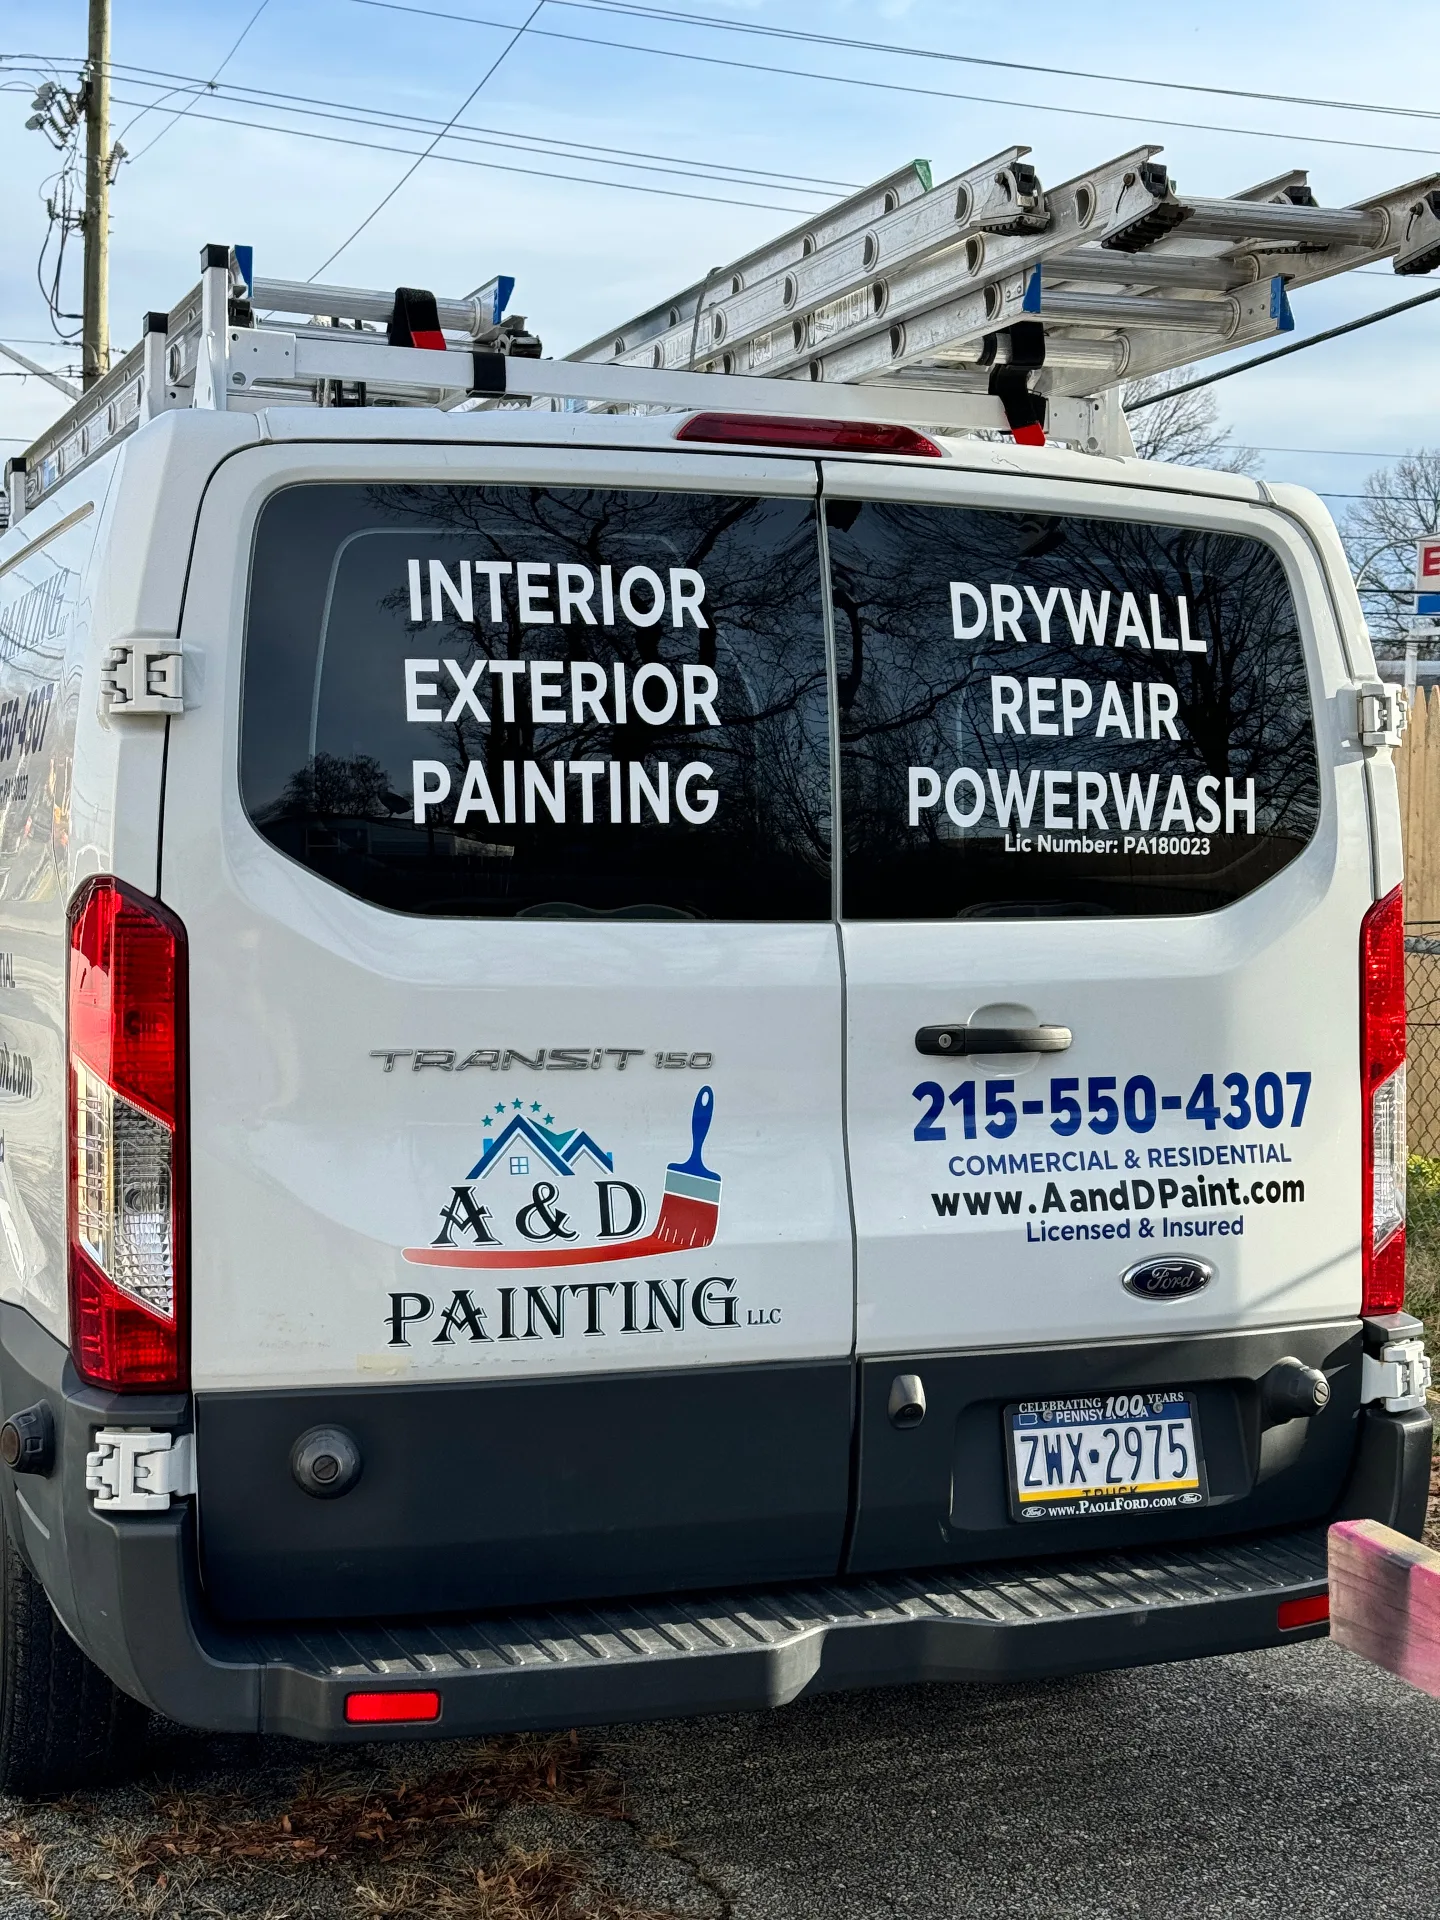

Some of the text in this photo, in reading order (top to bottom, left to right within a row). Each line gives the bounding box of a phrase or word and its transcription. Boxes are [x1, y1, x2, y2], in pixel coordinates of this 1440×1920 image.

[407, 559, 709, 629] INTERIOR
[950, 582, 1207, 652] DRYWALL
[404, 658, 721, 726] EXTERIOR
[991, 675, 1181, 741] REPAIR
[412, 760, 719, 825] PAINTING
[908, 766, 1256, 835] POWERWASH
[1004, 833, 1211, 855] Lic Number: PA180023
[653, 1051, 715, 1070] 150
[912, 1072, 1312, 1141] 215-550-4307
[948, 1143, 1292, 1176] COMMERCIAL & RESIDENTIAL
[428, 1179, 648, 1247] A & D
[931, 1174, 1305, 1217] www.AandDPaint.com
[1026, 1215, 1244, 1242] Licensed & Insured
[1146, 1266, 1195, 1291] Ford
[382, 1276, 782, 1348] PAINTING LLC
[1018, 1391, 1184, 1418] CELEBRATING 100 YEARS
[1055, 1404, 1149, 1423] PENNSYA
